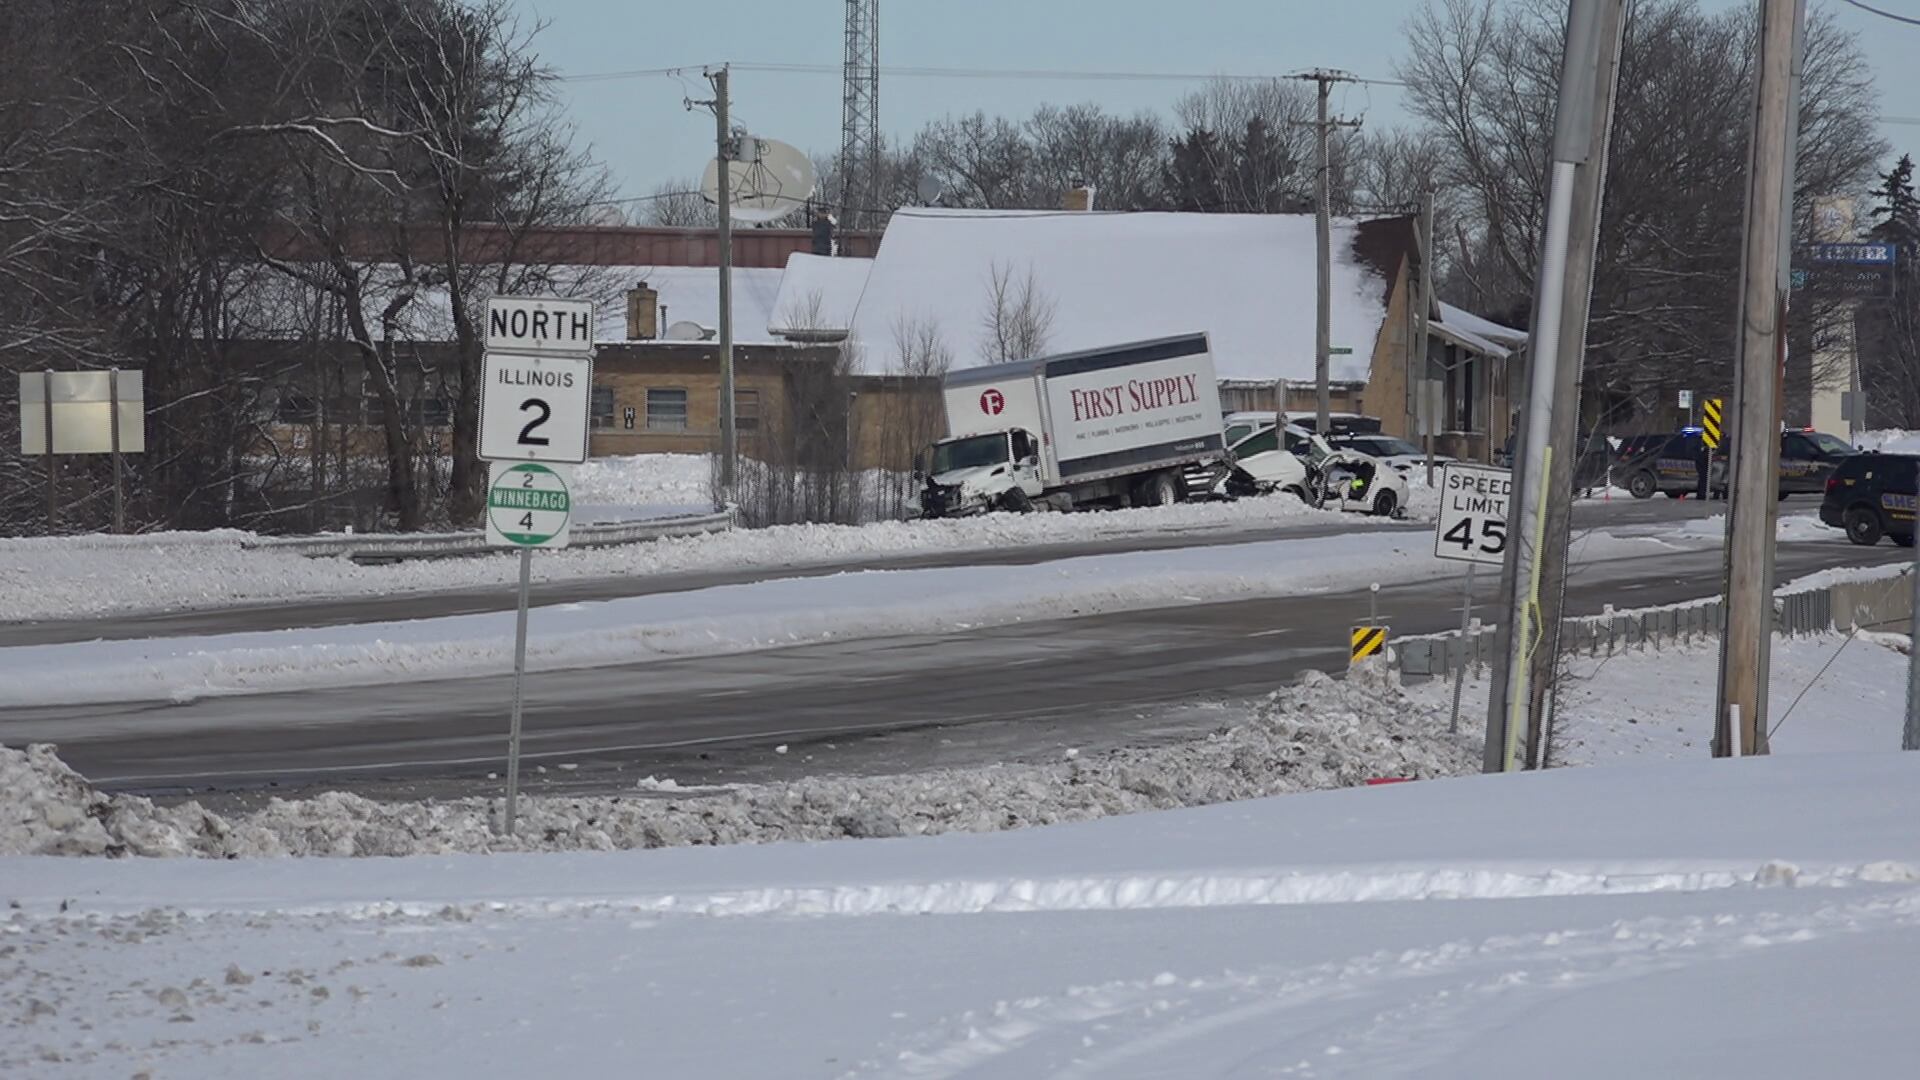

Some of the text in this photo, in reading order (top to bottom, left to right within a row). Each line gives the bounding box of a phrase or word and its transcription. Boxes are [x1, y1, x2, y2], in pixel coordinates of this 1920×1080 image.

[491, 308, 588, 341] NORTH
[499, 368, 574, 388] ILLINOIS
[1070, 373, 1197, 422] FIRST SUPPLY
[517, 398, 551, 446] 2
[523, 472, 534, 488] 2
[1449, 474, 1512, 495] SPEED
[493, 490, 567, 510] WINNEBAGO
[1453, 495, 1505, 514] LIMIT
[518, 511, 533, 531] 4
[1443, 517, 1507, 554] 45
